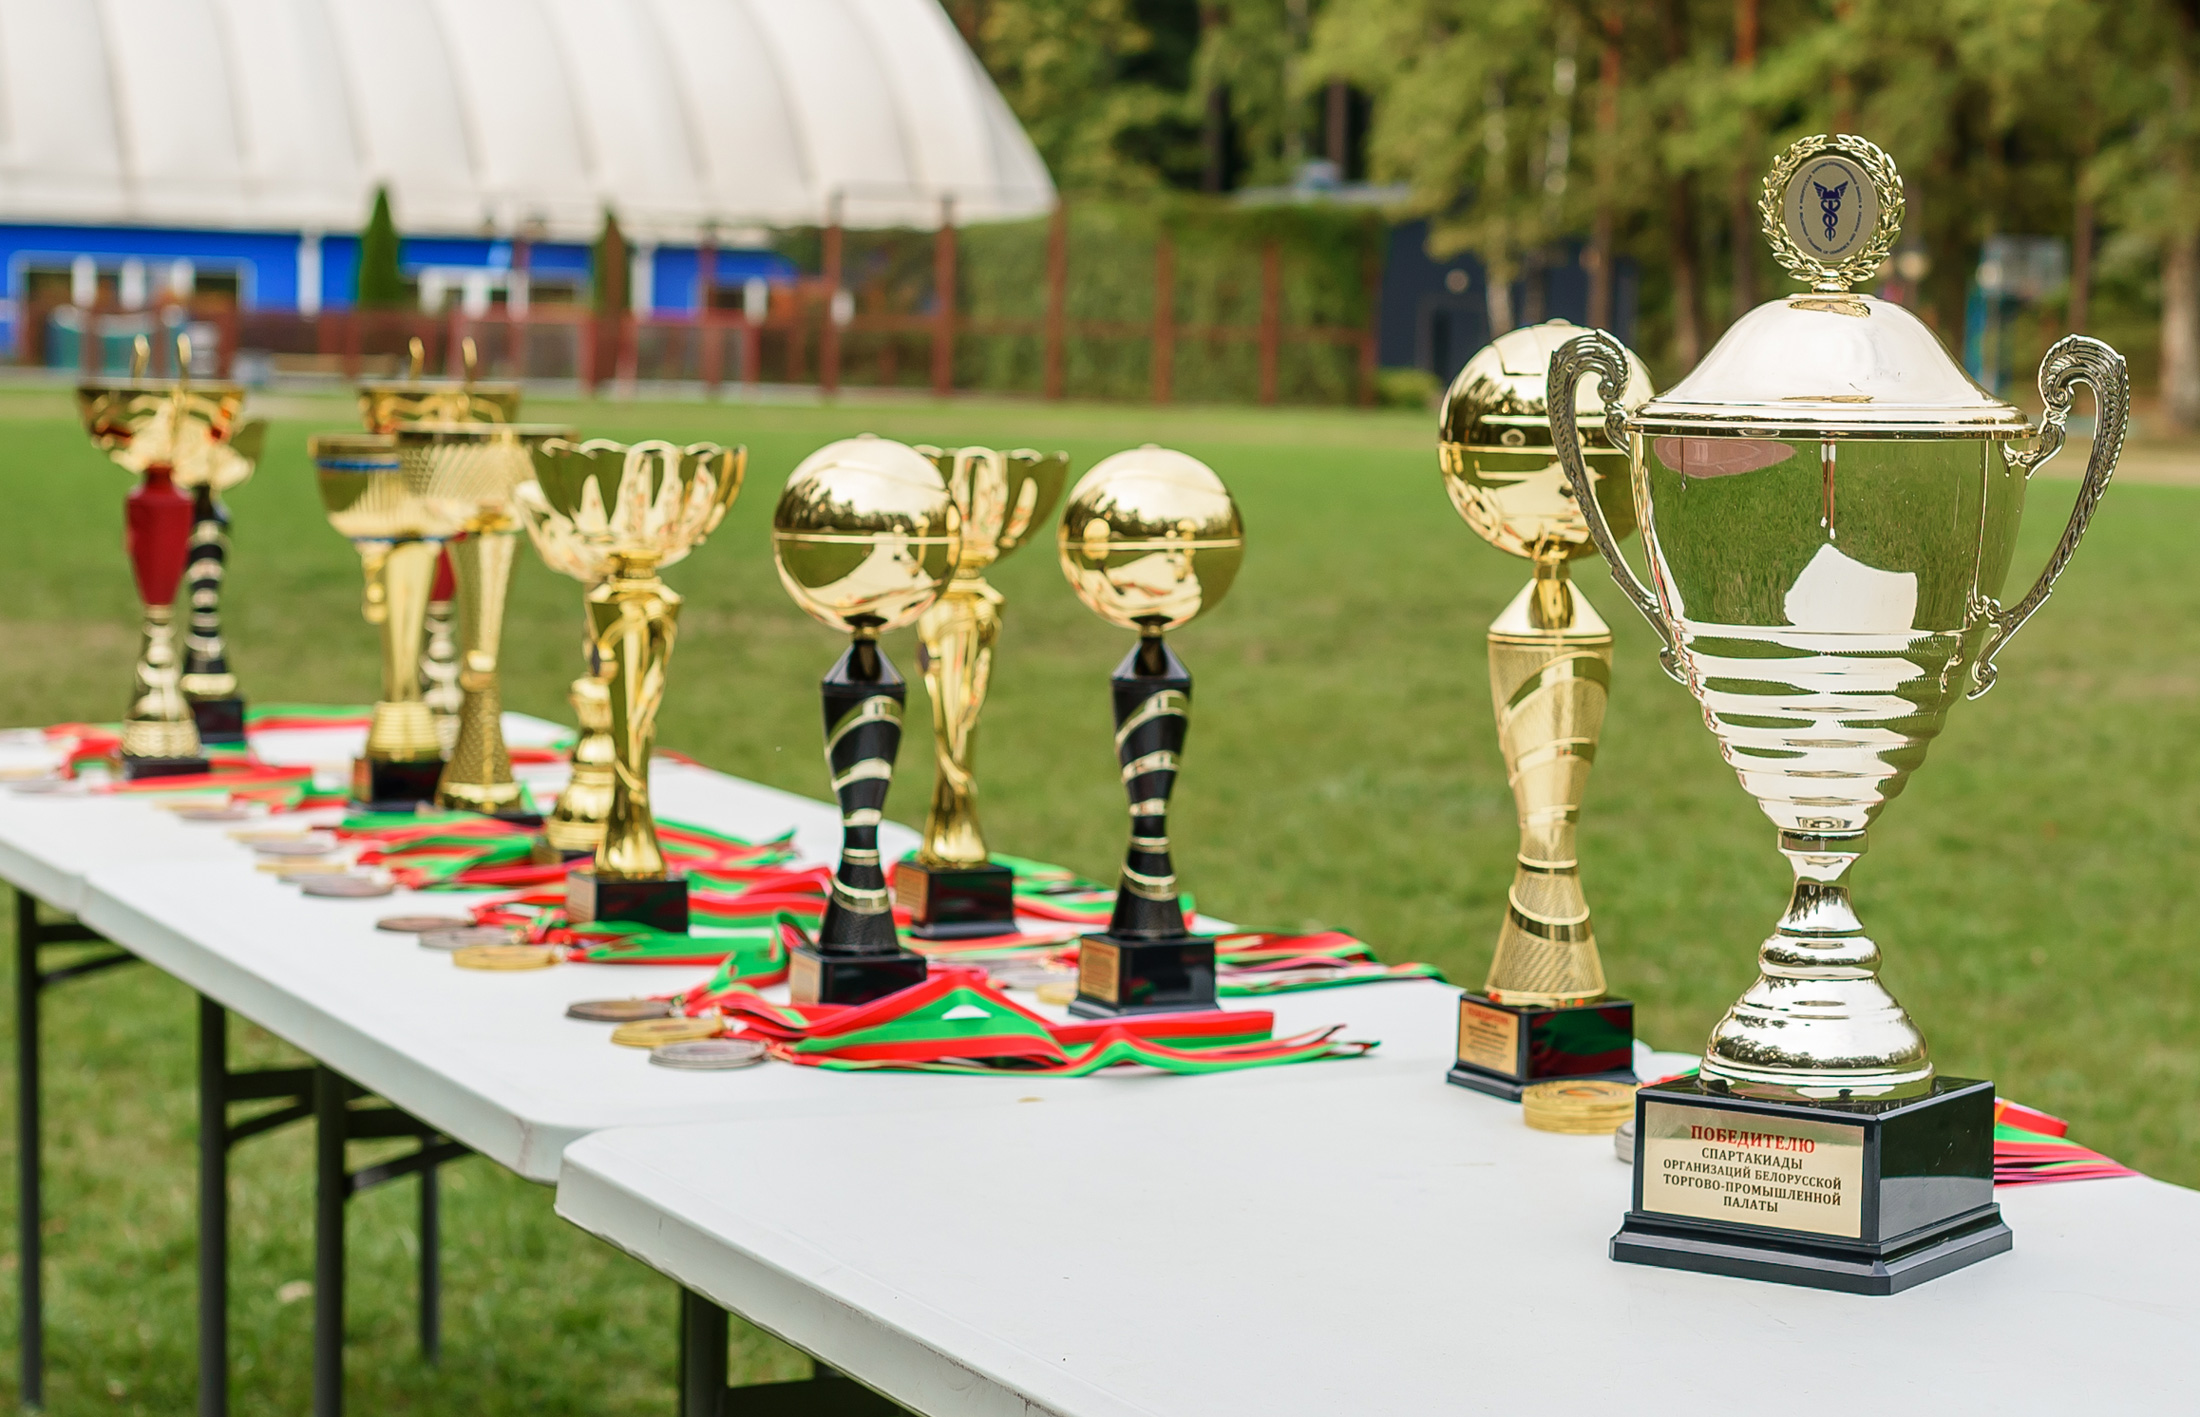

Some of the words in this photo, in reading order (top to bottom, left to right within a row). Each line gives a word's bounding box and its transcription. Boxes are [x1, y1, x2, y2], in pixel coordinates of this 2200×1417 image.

[1691, 1125, 1815, 1154] ПОБЕДИТЕЛЮ
[1701, 1147, 1803, 1170] СПАРТАКИАДЫ
[1663, 1159, 1751, 1179] ОРГАНИЗАЦИЙ
[1755, 1169, 1842, 1190] БЕЛОРУССКОЙ
[1663, 1173, 1841, 1206] ТОРГОВО-ПРОМЫШЛЕННОЙ
[1723, 1196, 1779, 1213] ПАЛАТЫ
